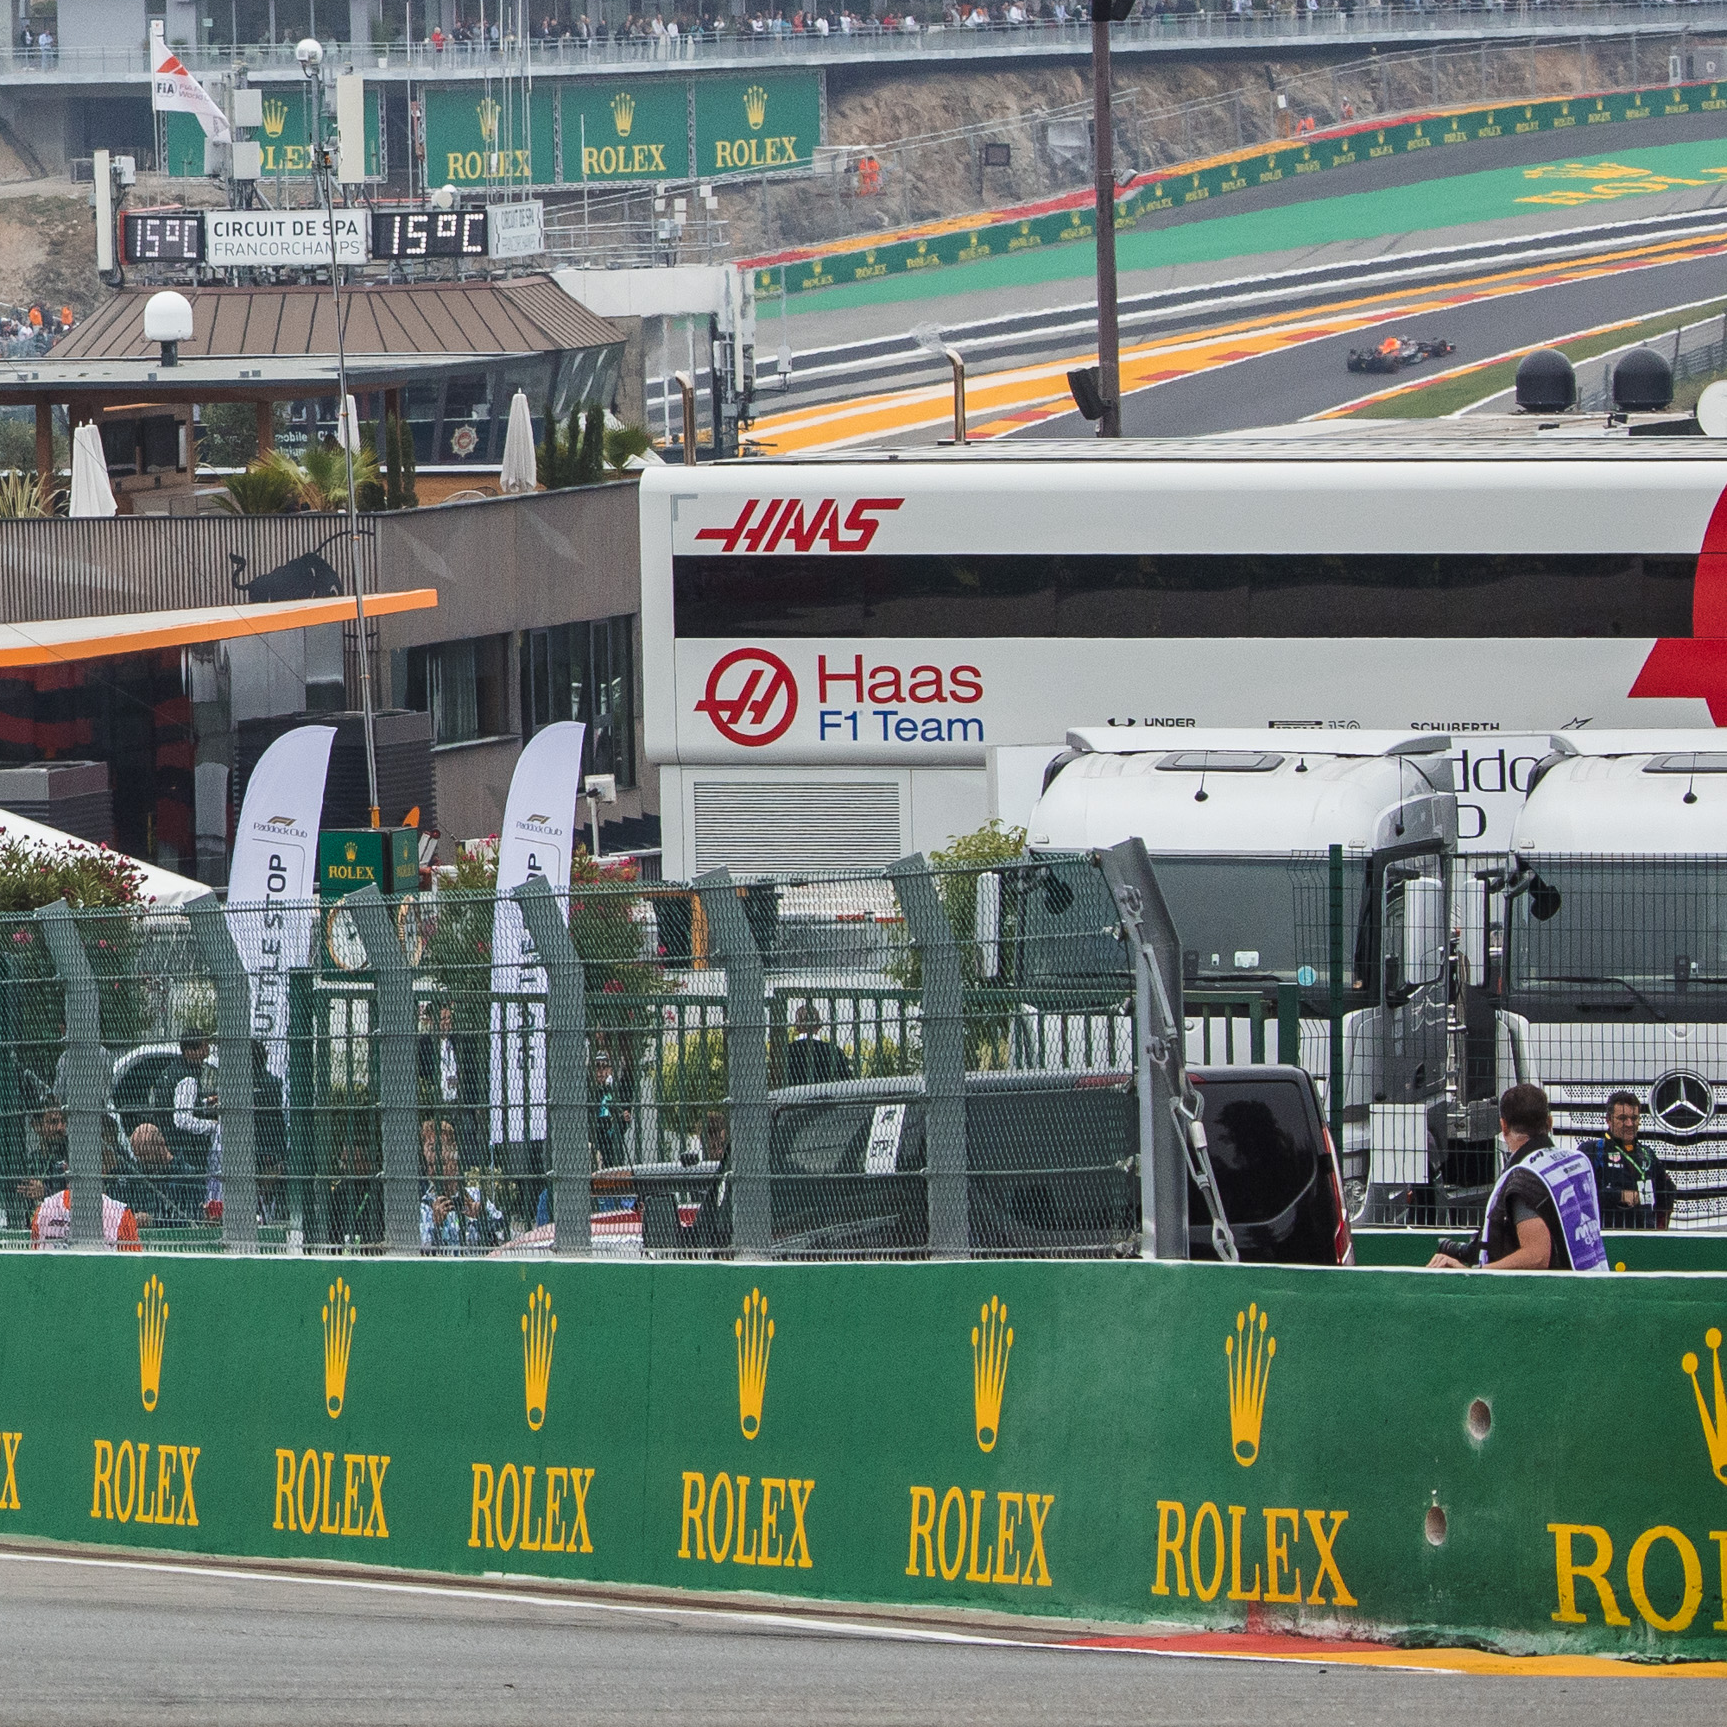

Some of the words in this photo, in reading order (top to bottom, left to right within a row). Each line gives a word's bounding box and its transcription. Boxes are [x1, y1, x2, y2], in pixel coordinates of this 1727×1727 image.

[447, 151, 530, 180] ROLEX
[582, 144, 667, 175] ROLEX
[715, 136, 799, 168] ROLEX
[213, 219, 289, 238] CIRCUIT
[292, 220, 316, 237] DE
[321, 219, 360, 237] SPA
[213, 240, 361, 258] FRANCORCHAMPS
[694, 498, 906, 553] HAAS
[818, 654, 984, 704] Haas
[819, 710, 859, 742] F1
[872, 710, 984, 743] Team
[1144, 718, 1196, 728] UNDER
[253, 822, 288, 836] Paddock
[288, 827, 308, 839] Club
[543, 825, 563, 837] Club
[328, 865, 375, 880] ROLEX
[254, 937, 281, 1033] UTTLE
[90, 1439, 201, 1526] ROLEX
[273, 1448, 391, 1538] ROLEX
[468, 1463, 595, 1553] ROLEX
[678, 1471, 816, 1569] ROLEX
[905, 1486, 1056, 1588] ROLEX
[1151, 1500, 1359, 1608] ROLEX
[1547, 1523, 1727, 1632] RO
